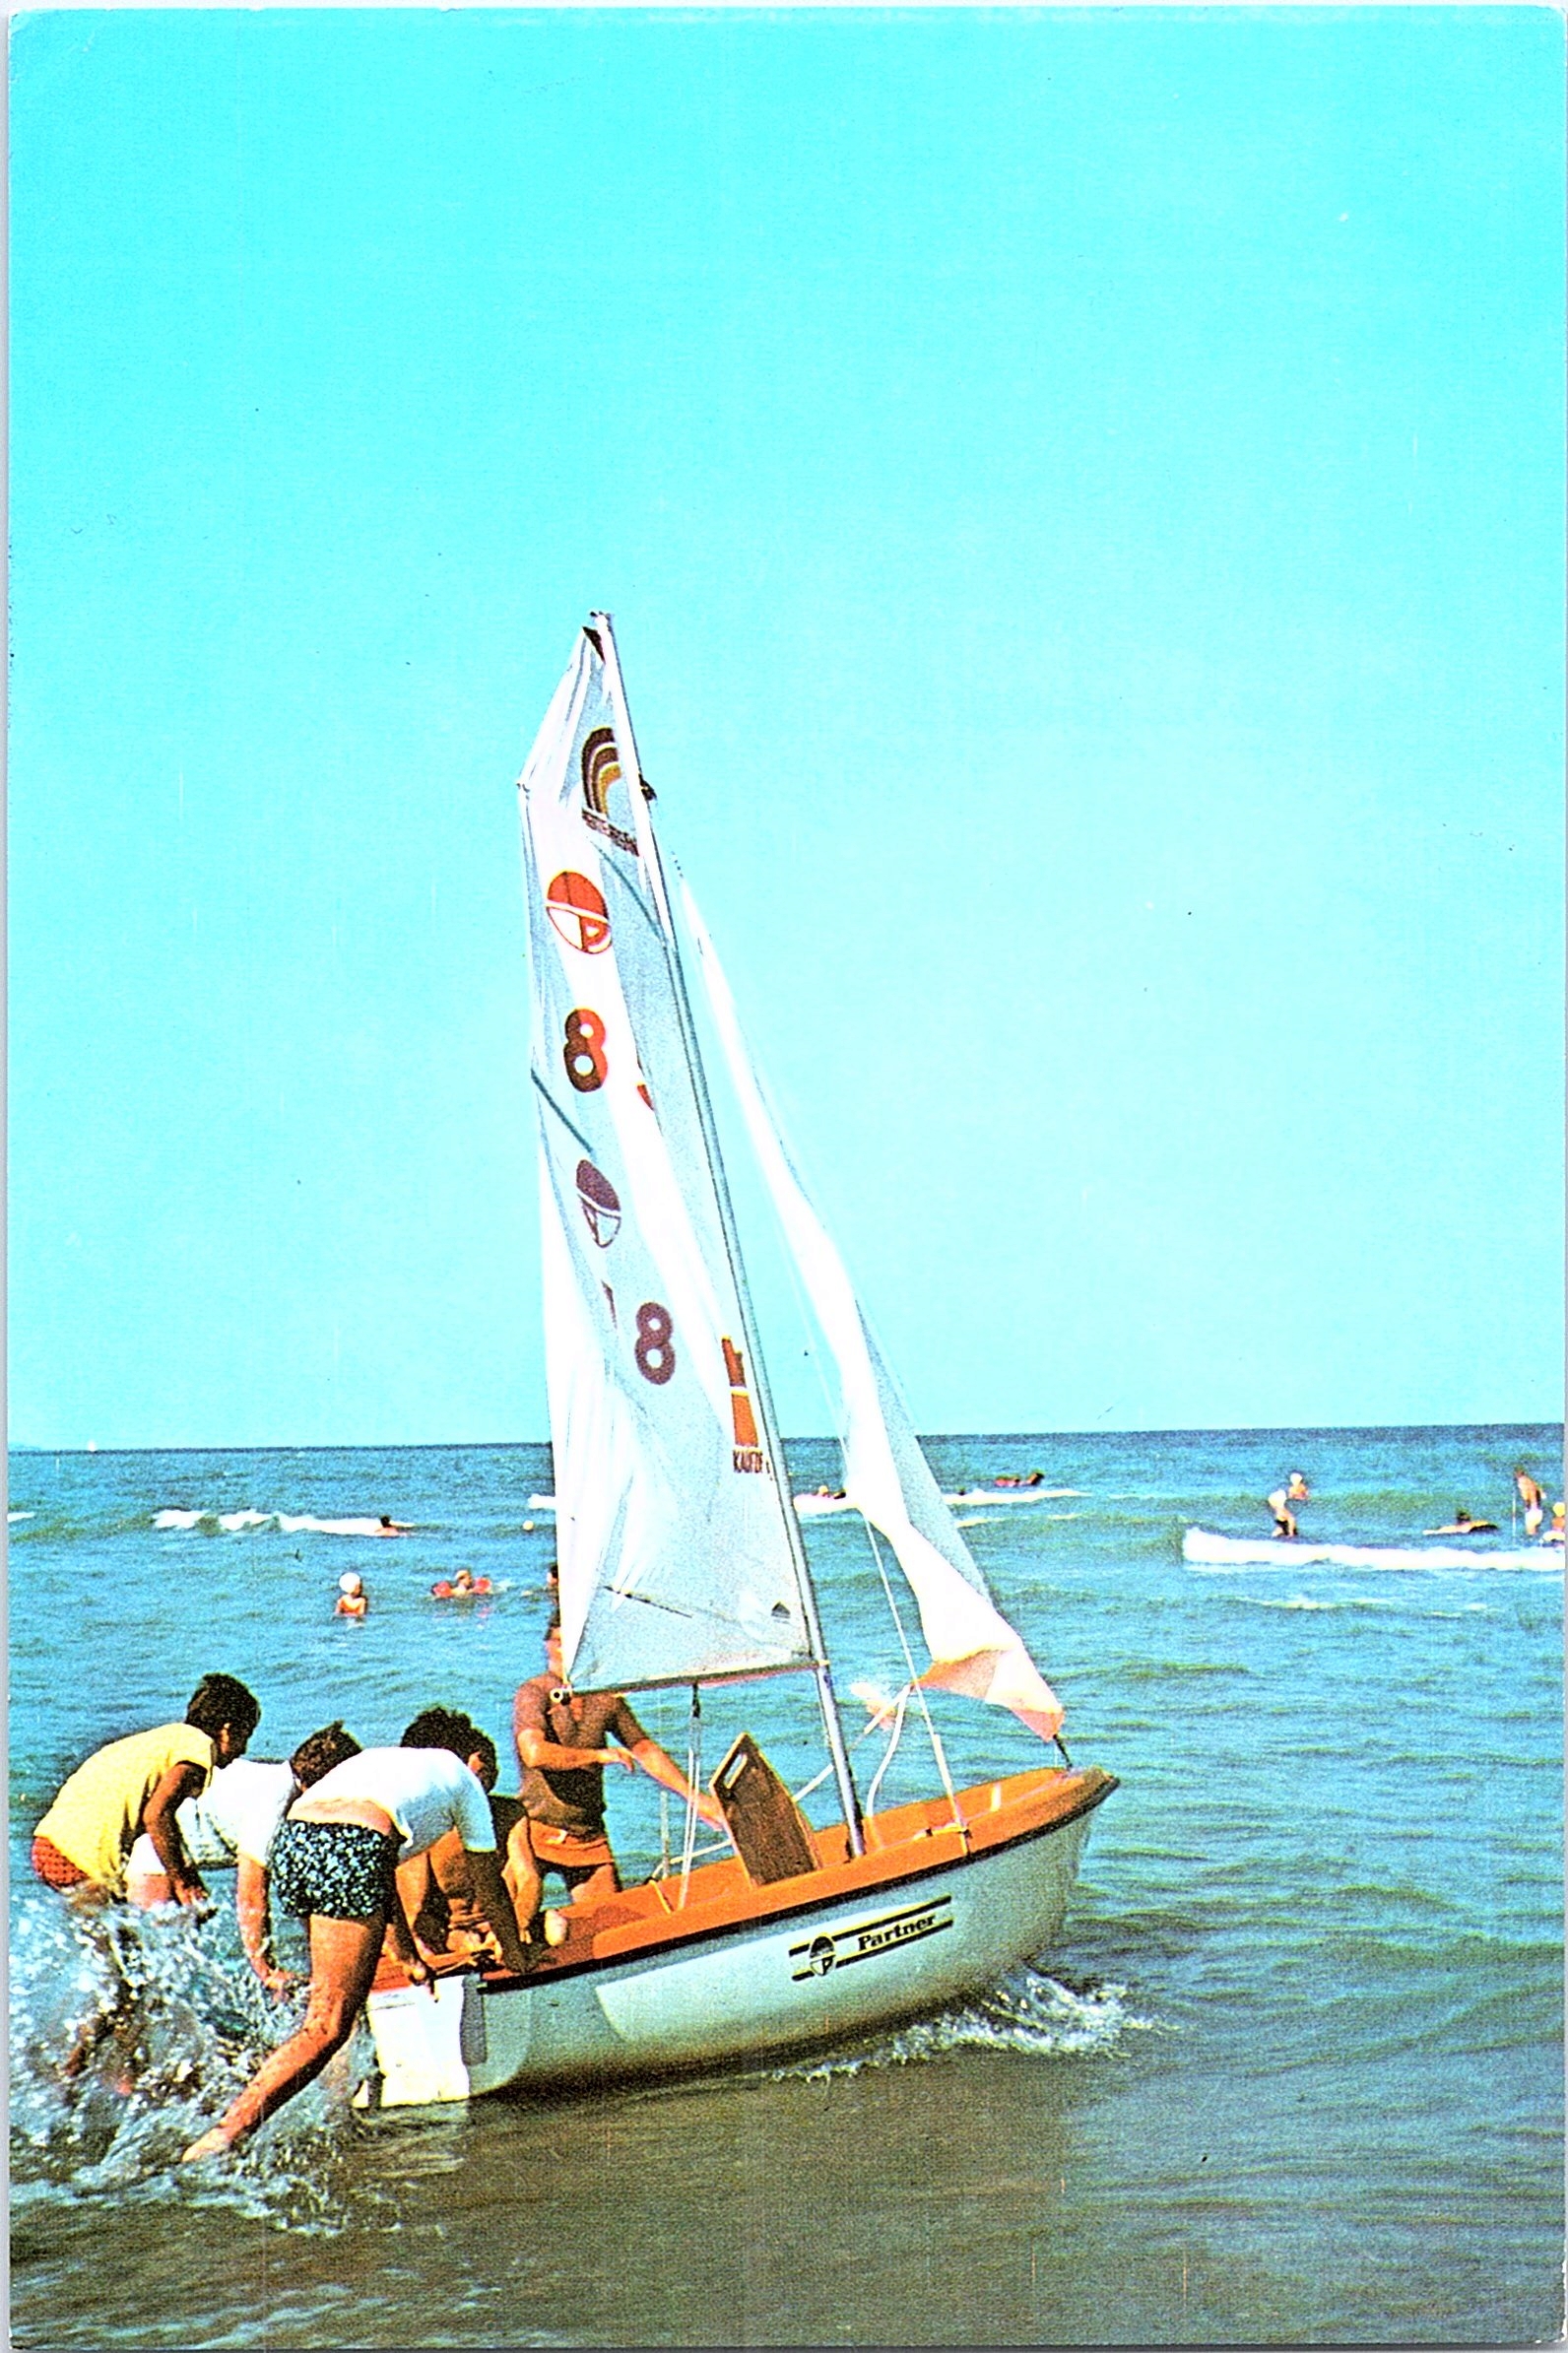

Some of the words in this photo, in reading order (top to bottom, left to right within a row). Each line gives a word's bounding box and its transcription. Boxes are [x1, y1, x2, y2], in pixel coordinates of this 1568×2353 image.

[564, 1009, 608, 1092] 8
[635, 1302, 676, 1385] 8
[859, 1916, 936, 1951] Partner
